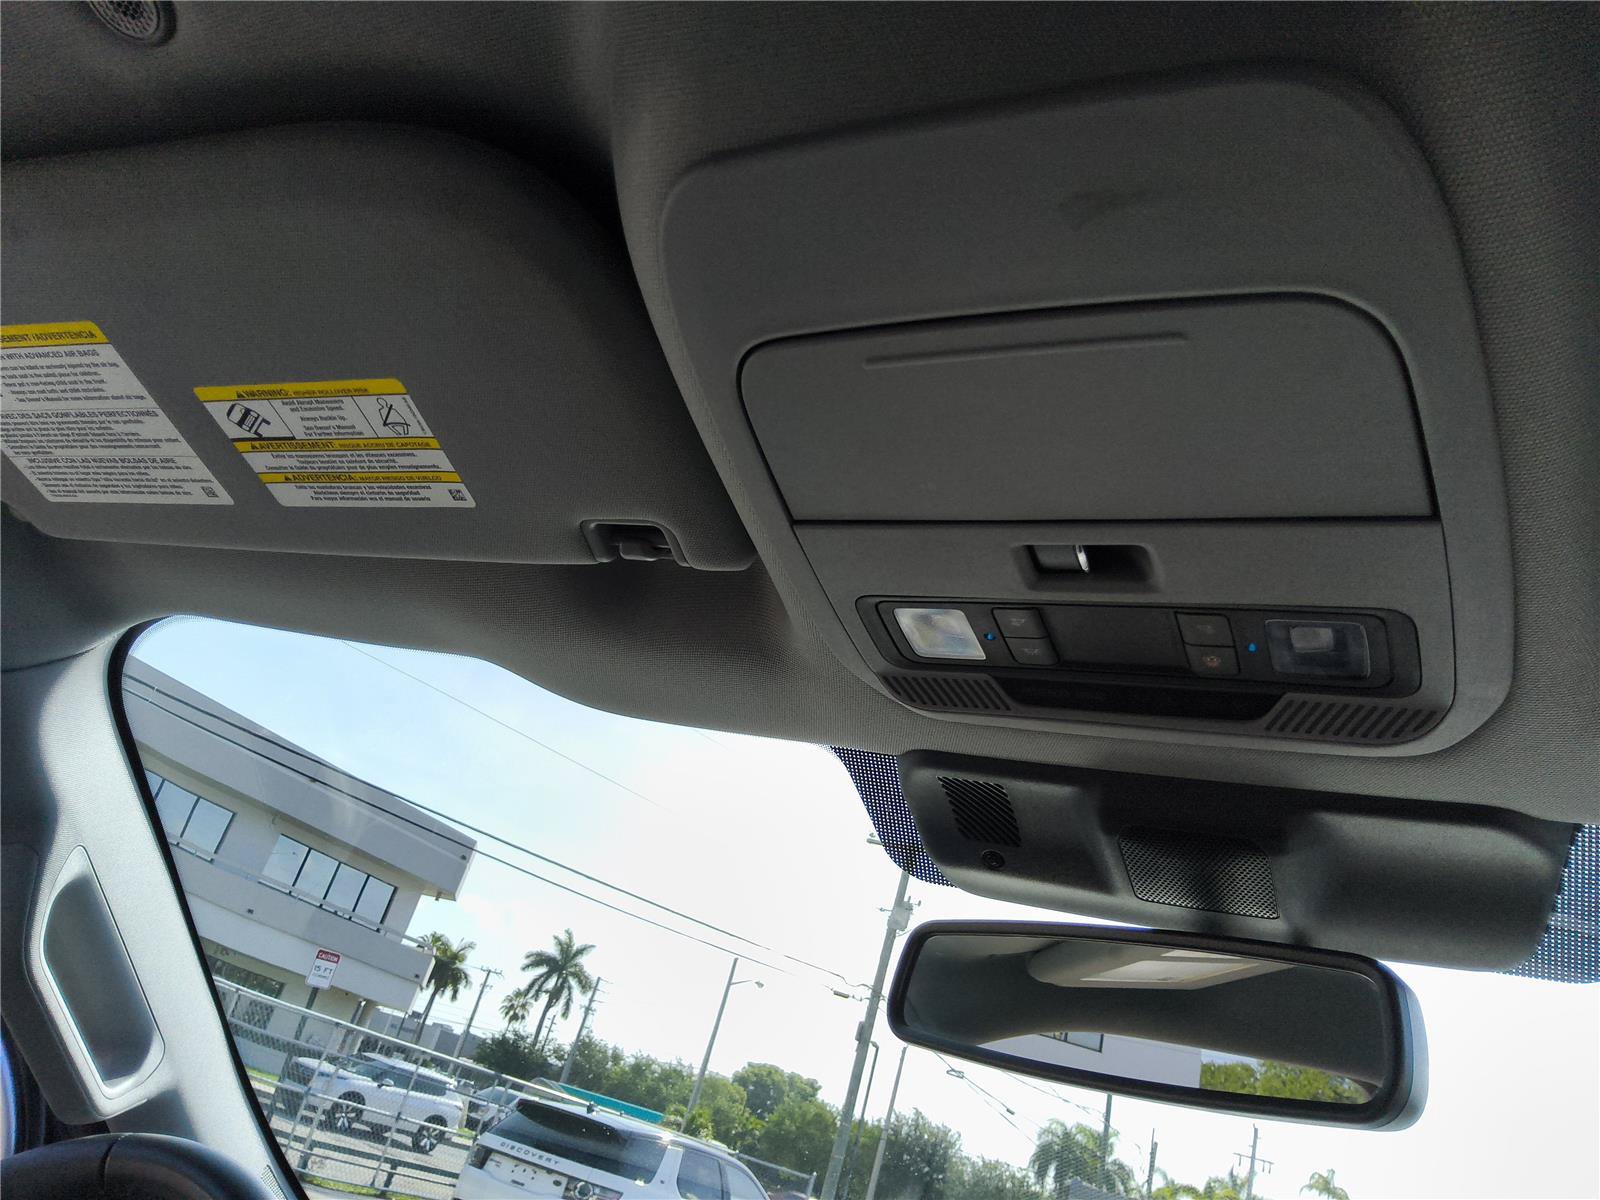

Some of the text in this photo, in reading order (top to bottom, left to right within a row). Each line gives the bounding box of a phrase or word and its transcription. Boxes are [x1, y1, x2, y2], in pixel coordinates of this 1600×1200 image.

[6, 352, 25, 360] WITH
[24, 351, 63, 360] ADVANCED
[79, 349, 99, 357] BAGS
[500, 1141, 560, 1166] DISCOVERY
